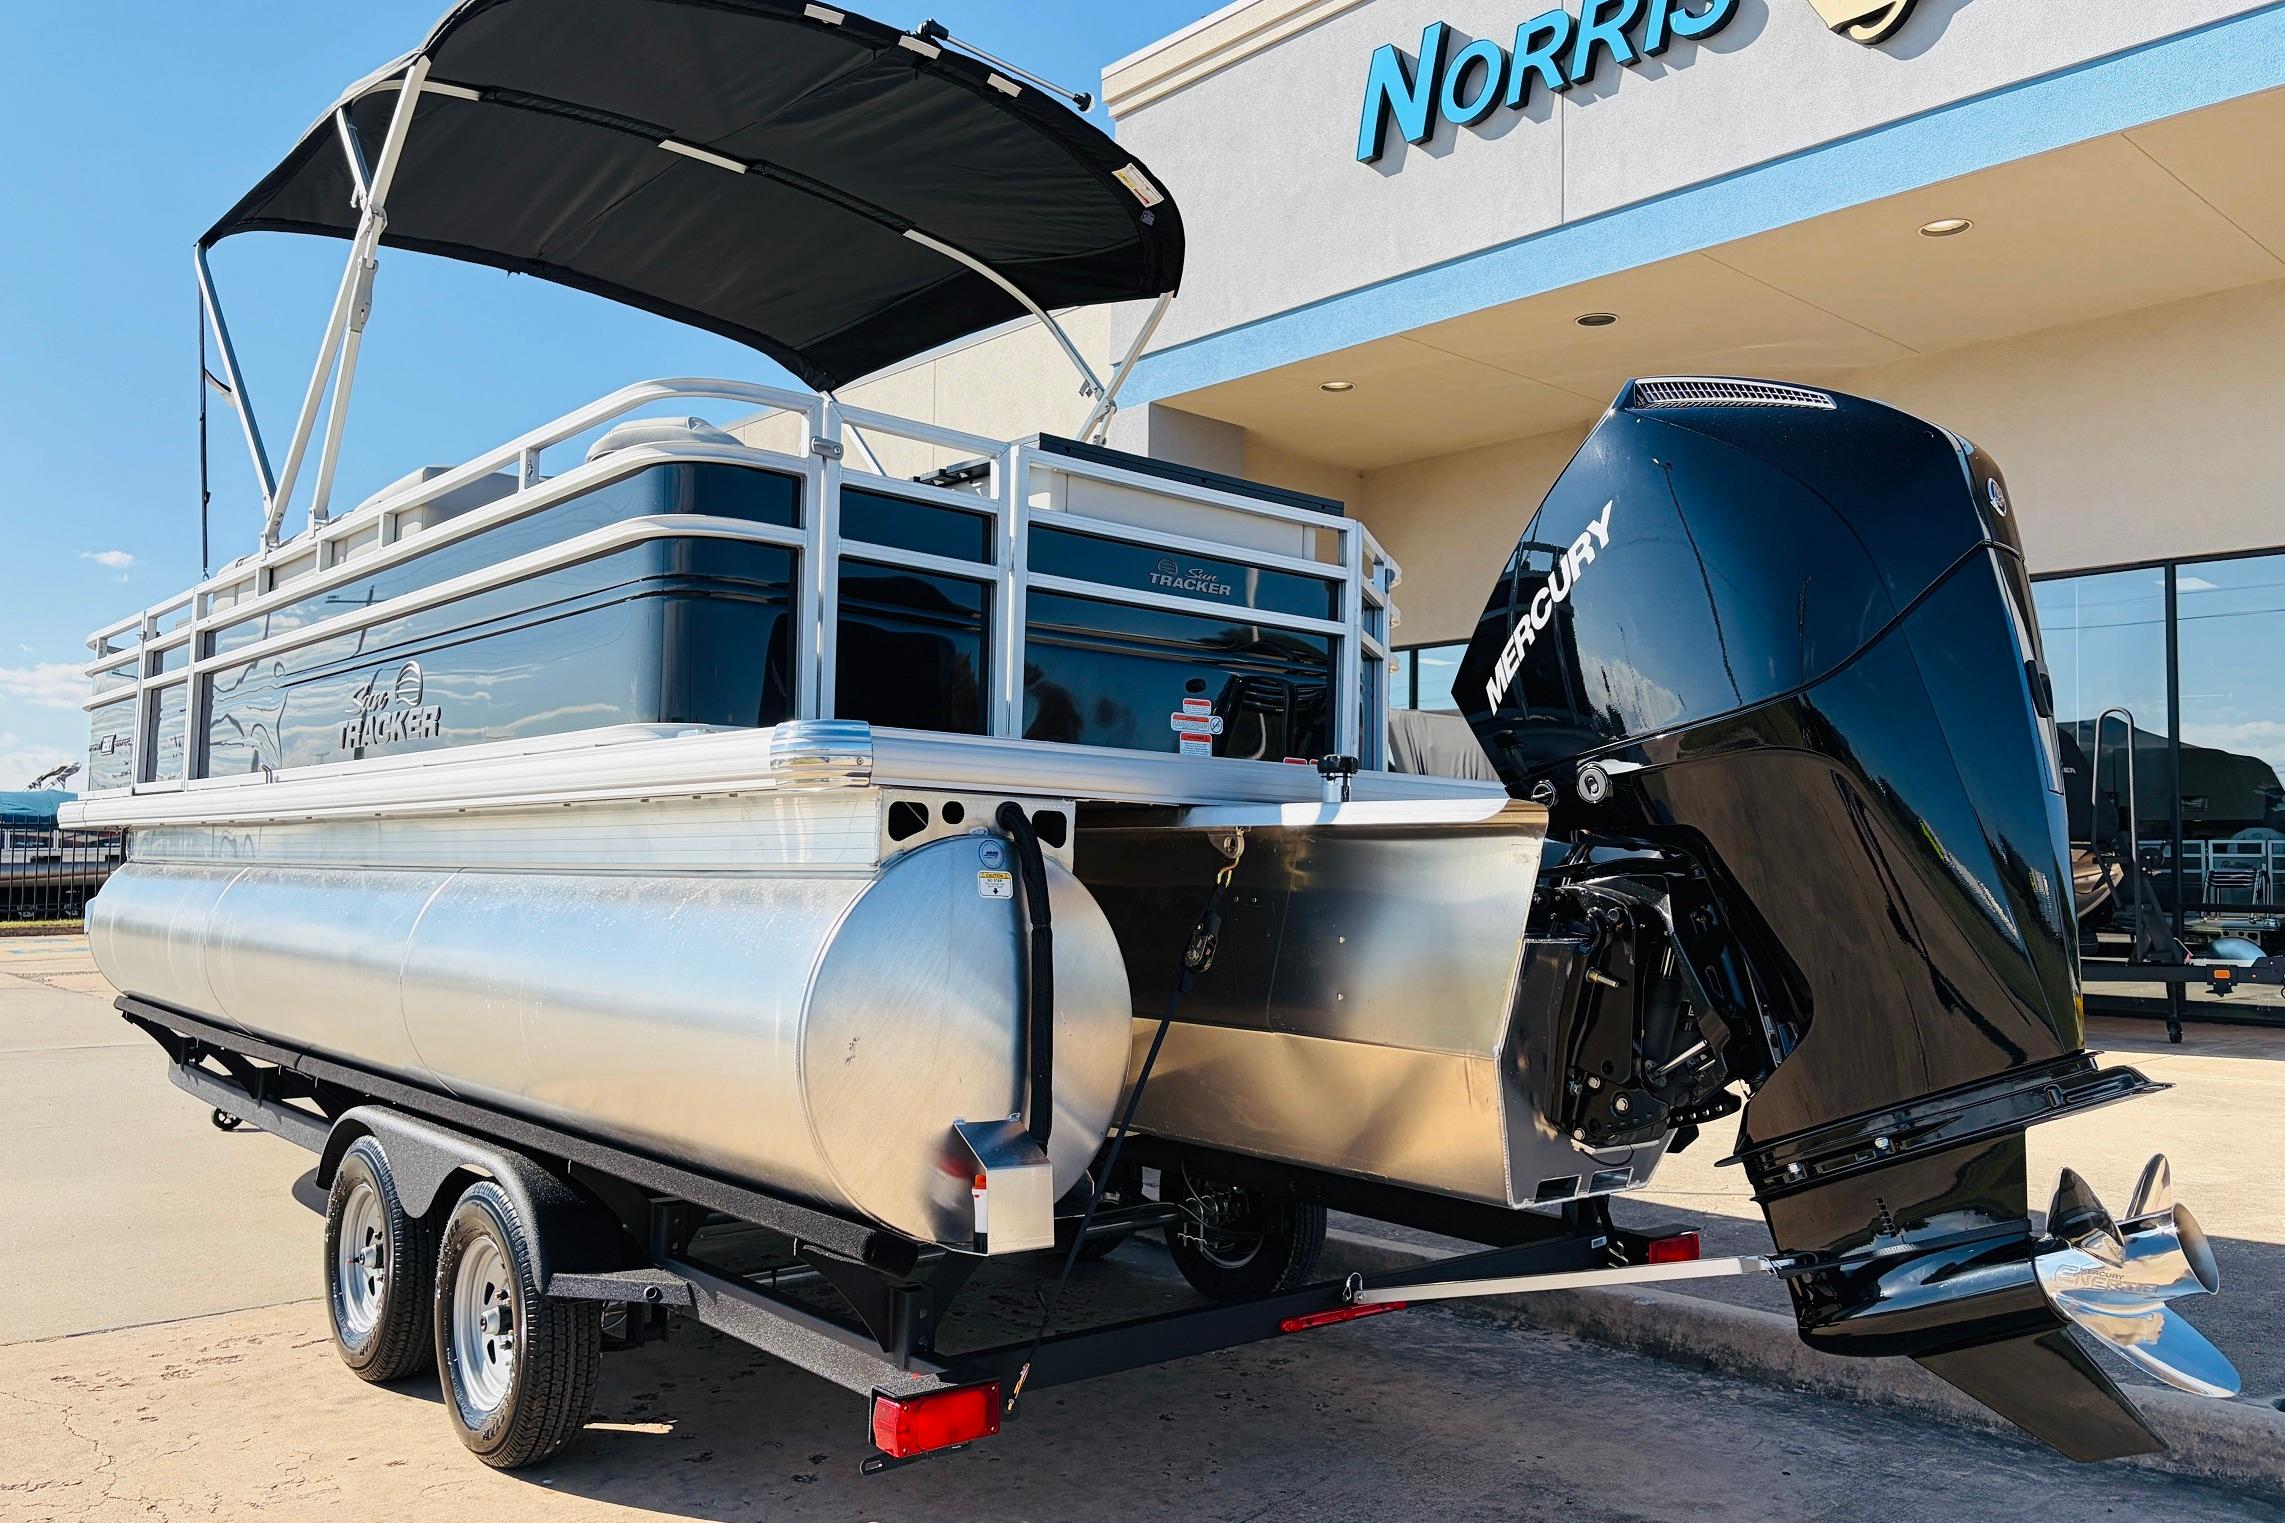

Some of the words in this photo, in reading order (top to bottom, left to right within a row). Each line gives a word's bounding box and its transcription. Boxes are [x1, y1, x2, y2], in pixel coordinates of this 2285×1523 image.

[1149, 572, 1232, 596] TRACKER
[1185, 568, 1218, 582] Sun
[1486, 500, 1613, 716] MERCURY
[345, 683, 389, 715] Sun
[338, 705, 442, 750] TRACKER
[2080, 1267, 2125, 1280] MERCURY
